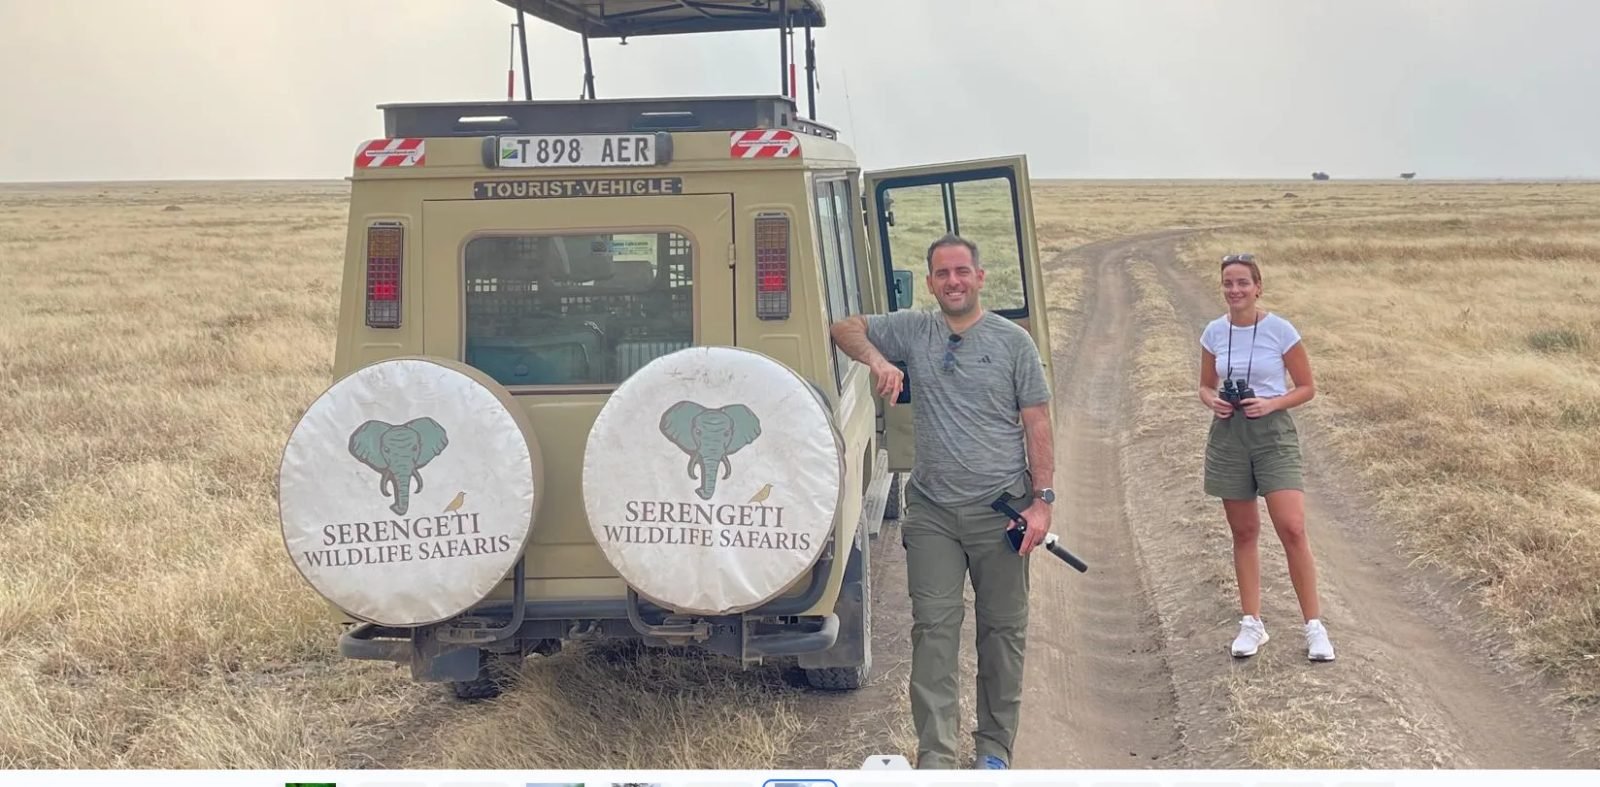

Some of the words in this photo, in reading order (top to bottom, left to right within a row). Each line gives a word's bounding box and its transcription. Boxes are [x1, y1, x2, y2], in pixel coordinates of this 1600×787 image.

[517, 139, 530, 163] T
[536, 138, 581, 163] 898
[601, 137, 649, 163] AER
[484, 181, 576, 197] TOURIST
[583, 179, 673, 195] VEHICLE
[625, 500, 784, 528] SERENGETI
[323, 512, 480, 546] SERENGETI
[603, 525, 714, 547] WILDLIFE
[719, 529, 811, 551] SAFARIS
[304, 544, 413, 568] WILDLIFE
[418, 534, 511, 561] SAFARIS
